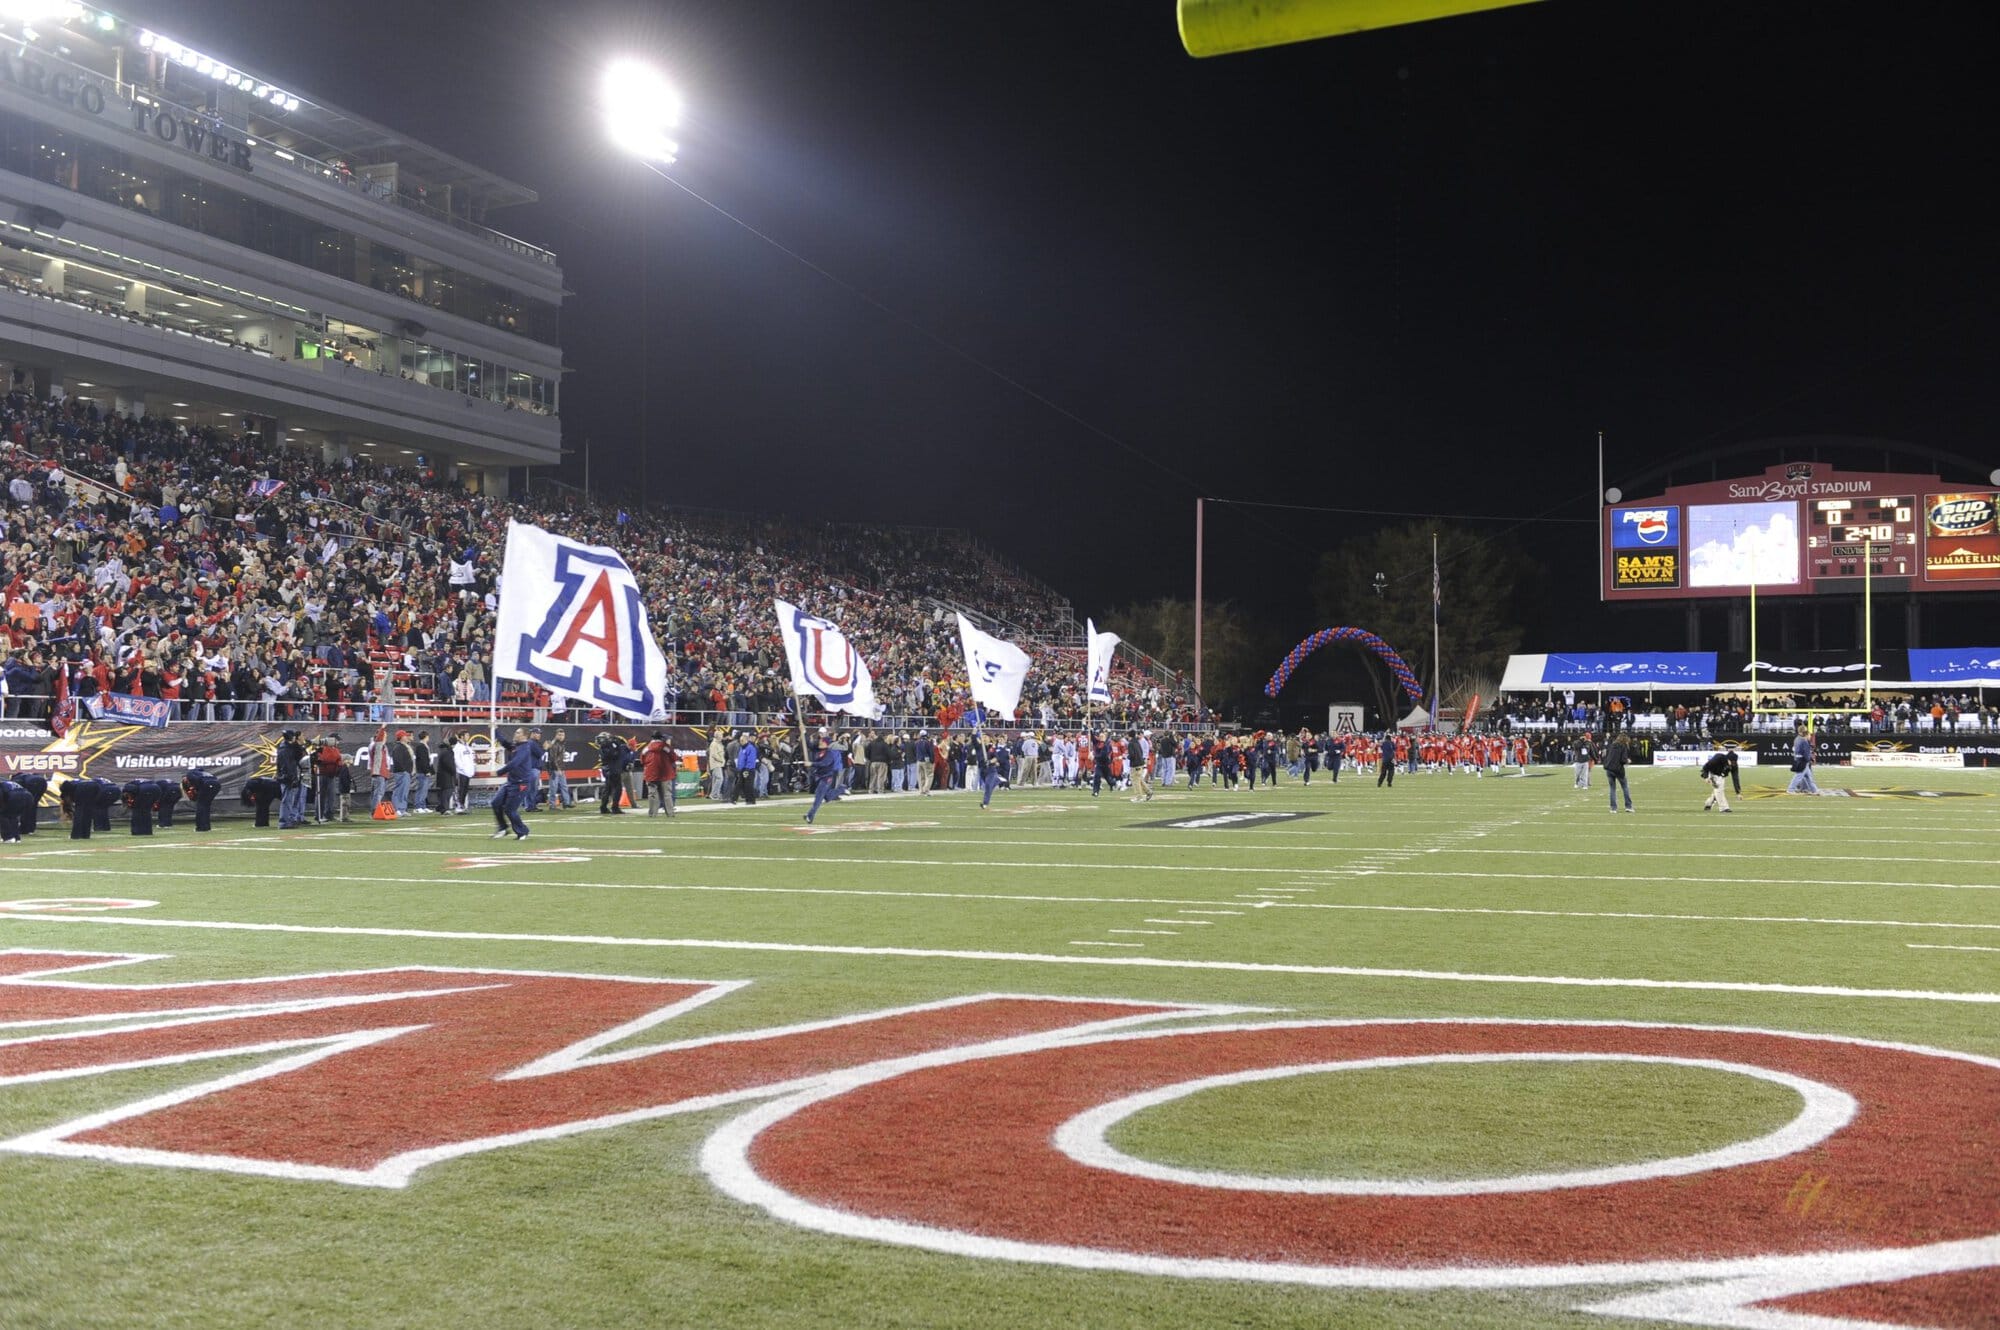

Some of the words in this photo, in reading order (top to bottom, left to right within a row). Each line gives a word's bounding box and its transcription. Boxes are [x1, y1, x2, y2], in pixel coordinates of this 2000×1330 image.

[134, 103, 253, 172] TOWER
[1729, 483, 1760, 498] Sam
[1759, 480, 1808, 501] Boyd
[1811, 481, 1872, 494] STADIUM
[1896, 507, 1911, 522] 0
[1941, 501, 1986, 515] BUD
[1623, 510, 1669, 523] PEPSI
[1827, 510, 1841, 525] 0
[1935, 509, 1992, 524] LIGHT
[1845, 525, 1892, 541] 2:40
[1906, 533, 1916, 544] 3
[1808, 536, 1818, 547] 3
[1618, 556, 1674, 568] SAM'S
[1926, 554, 2000, 565] SUMMERLIN
[1618, 567, 1674, 579] TOWN
[516, 543, 654, 717] A
[793, 609, 858, 705] U
[1919, 745, 1947, 753] Desert
[1956, 746, 1976, 754] Auto
[5, 754, 80, 771] VEGAS
[116, 754, 242, 770] VisitLasVegas.com
[383, 802, 395, 816] 20
